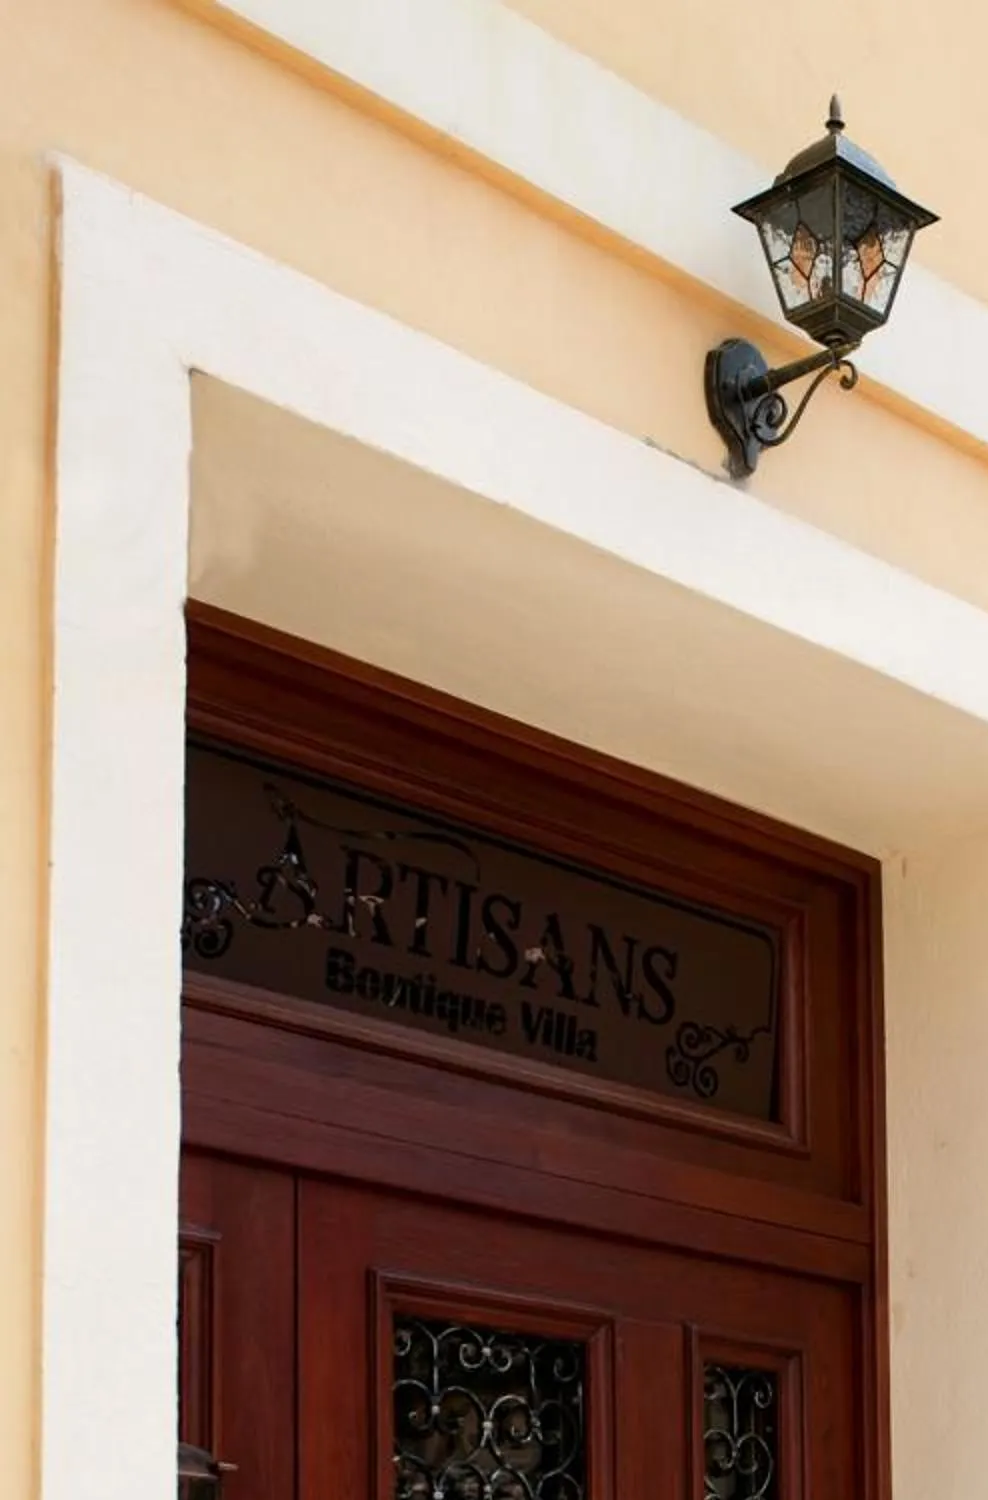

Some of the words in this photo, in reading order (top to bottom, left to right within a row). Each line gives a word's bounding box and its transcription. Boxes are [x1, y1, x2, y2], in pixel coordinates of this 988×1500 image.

[250, 810, 679, 1026] ARTISANS
[325, 946, 507, 1038] Boutique
[521, 1001, 598, 1063] Villa
